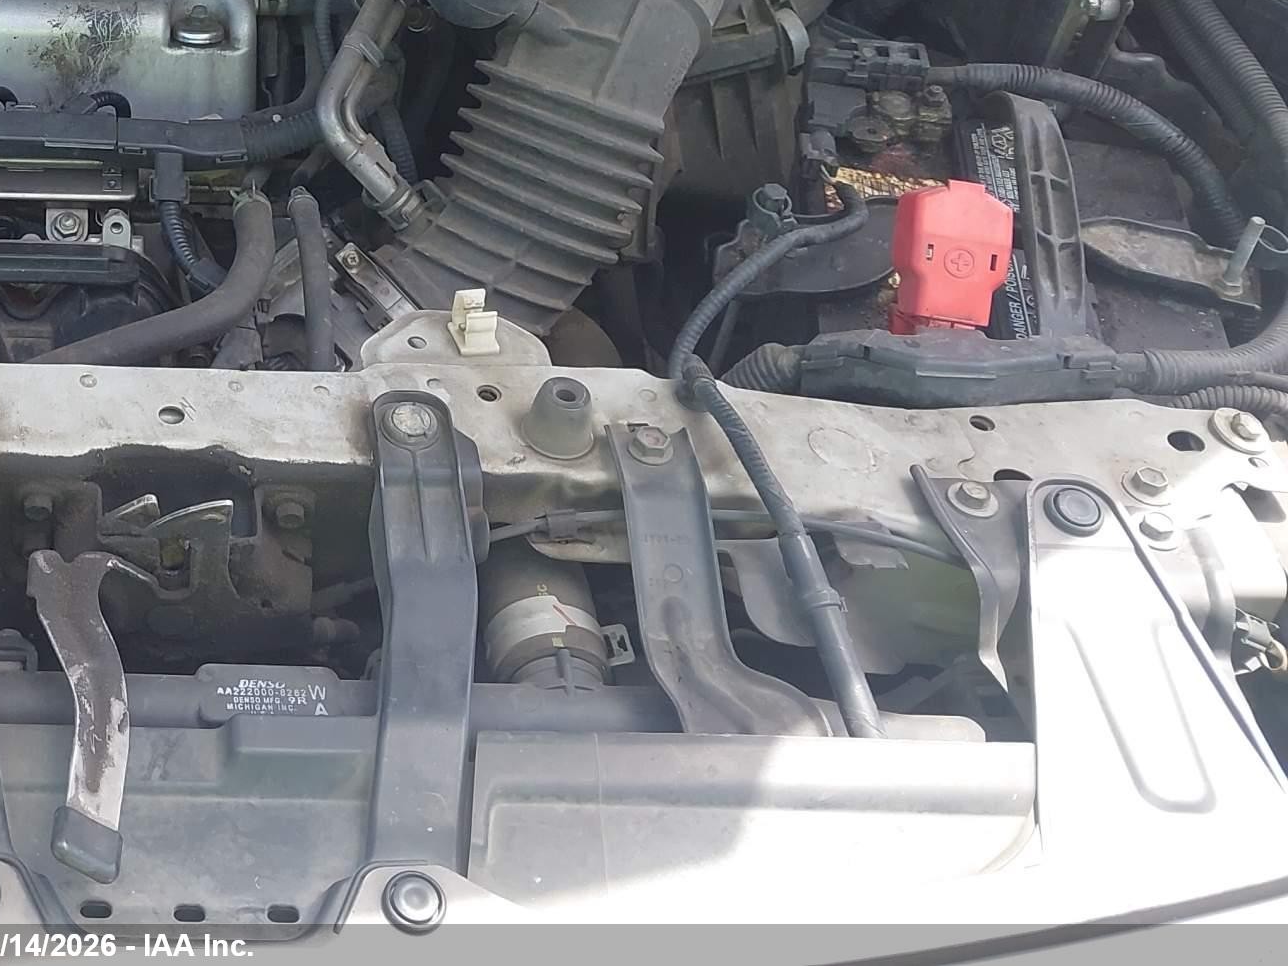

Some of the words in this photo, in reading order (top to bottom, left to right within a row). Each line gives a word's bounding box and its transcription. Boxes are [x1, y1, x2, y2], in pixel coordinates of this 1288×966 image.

[1008, 301, 1028, 340] DANGER
[238, 679, 286, 689] DENSO
[233, 696, 261, 704] DENSO
[226, 703, 274, 711] MICHIGAN
